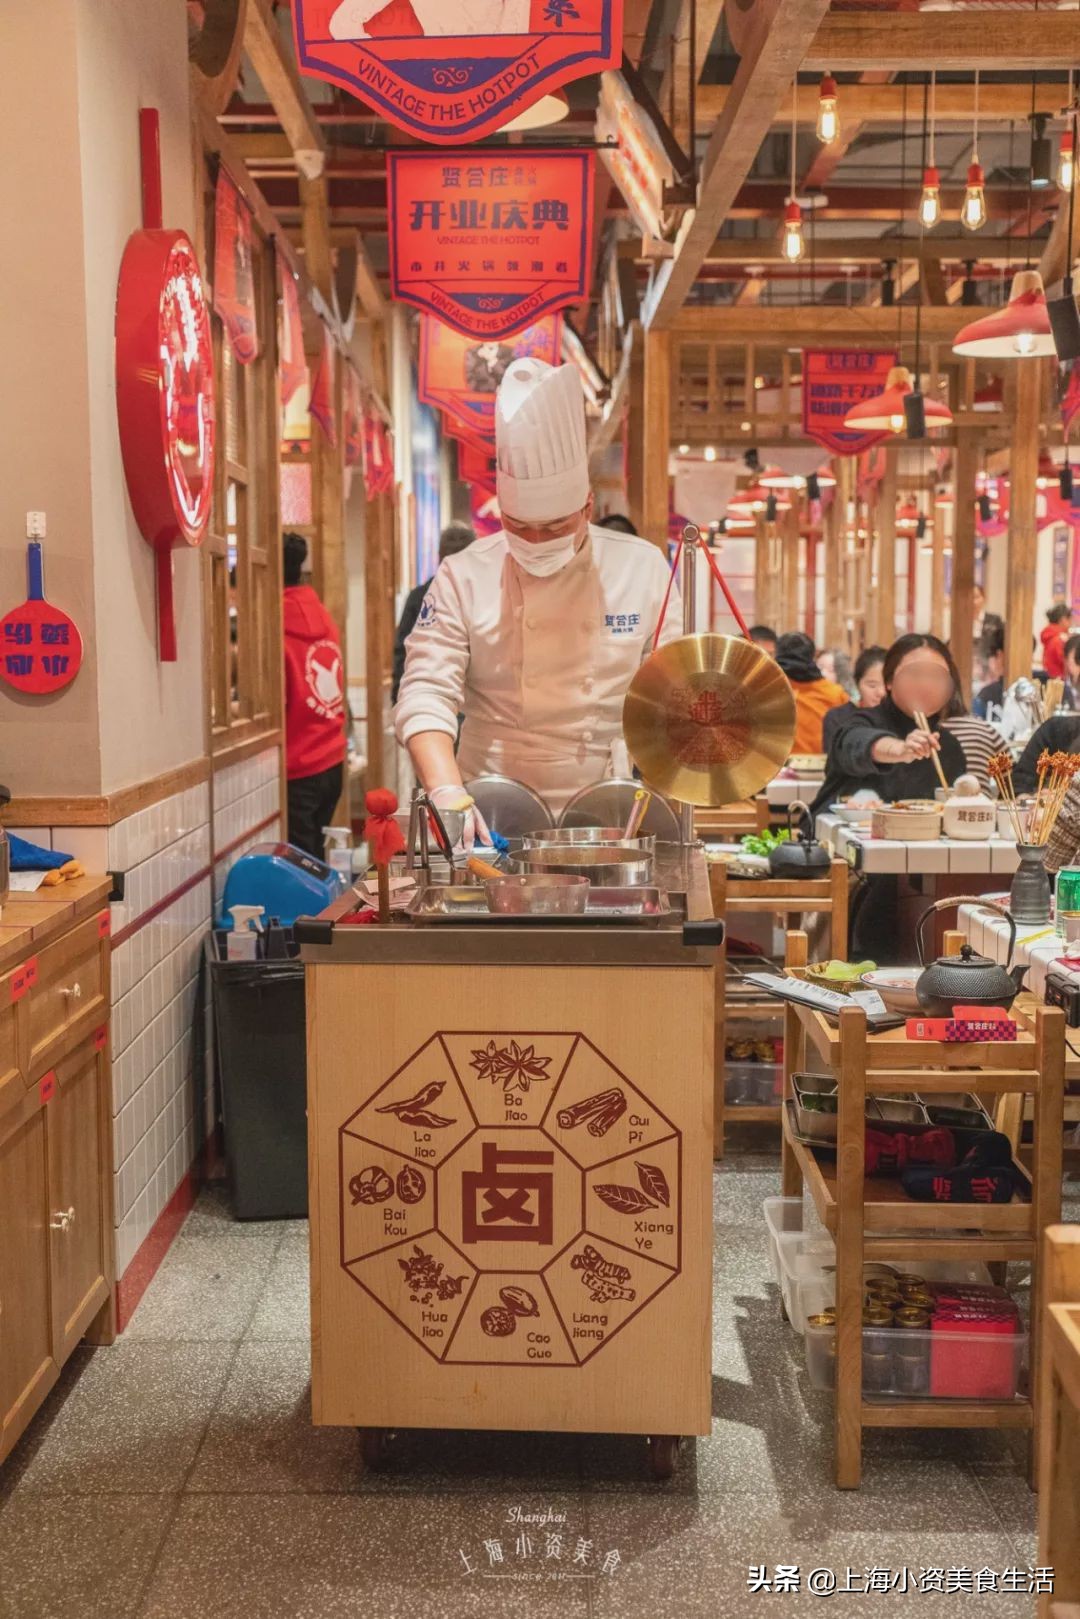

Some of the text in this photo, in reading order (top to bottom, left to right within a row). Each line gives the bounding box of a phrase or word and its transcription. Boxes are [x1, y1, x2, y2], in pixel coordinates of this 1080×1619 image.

[358, 53, 540, 121] VINTAGE THE HOTPOT
[409, 199, 569, 231] 开业庆典
[437, 236, 540, 245] VINTAGE THE HOTPOT
[431, 291, 545, 330] VINTAGE THE HOTPOT
[504, 1094, 523, 1106] Ba
[504, 1110, 528, 1122] Jiao
[628, 1115, 650, 1127] Gui
[413, 1130, 431, 1142] La
[629, 1130, 643, 1143] Pi
[413, 1146, 436, 1158] Jiao
[383, 1208, 406, 1221] Bai
[384, 1223, 407, 1236] Kou
[634, 1221, 674, 1235] Xiang
[634, 1237, 653, 1249] Ye
[422, 1311, 448, 1323] Hua
[572, 1312, 608, 1326] Liang
[422, 1326, 444, 1338] Jiao
[526, 1332, 551, 1344] Cao
[572, 1327, 605, 1340] Jiang
[526, 1348, 552, 1359] Guo
